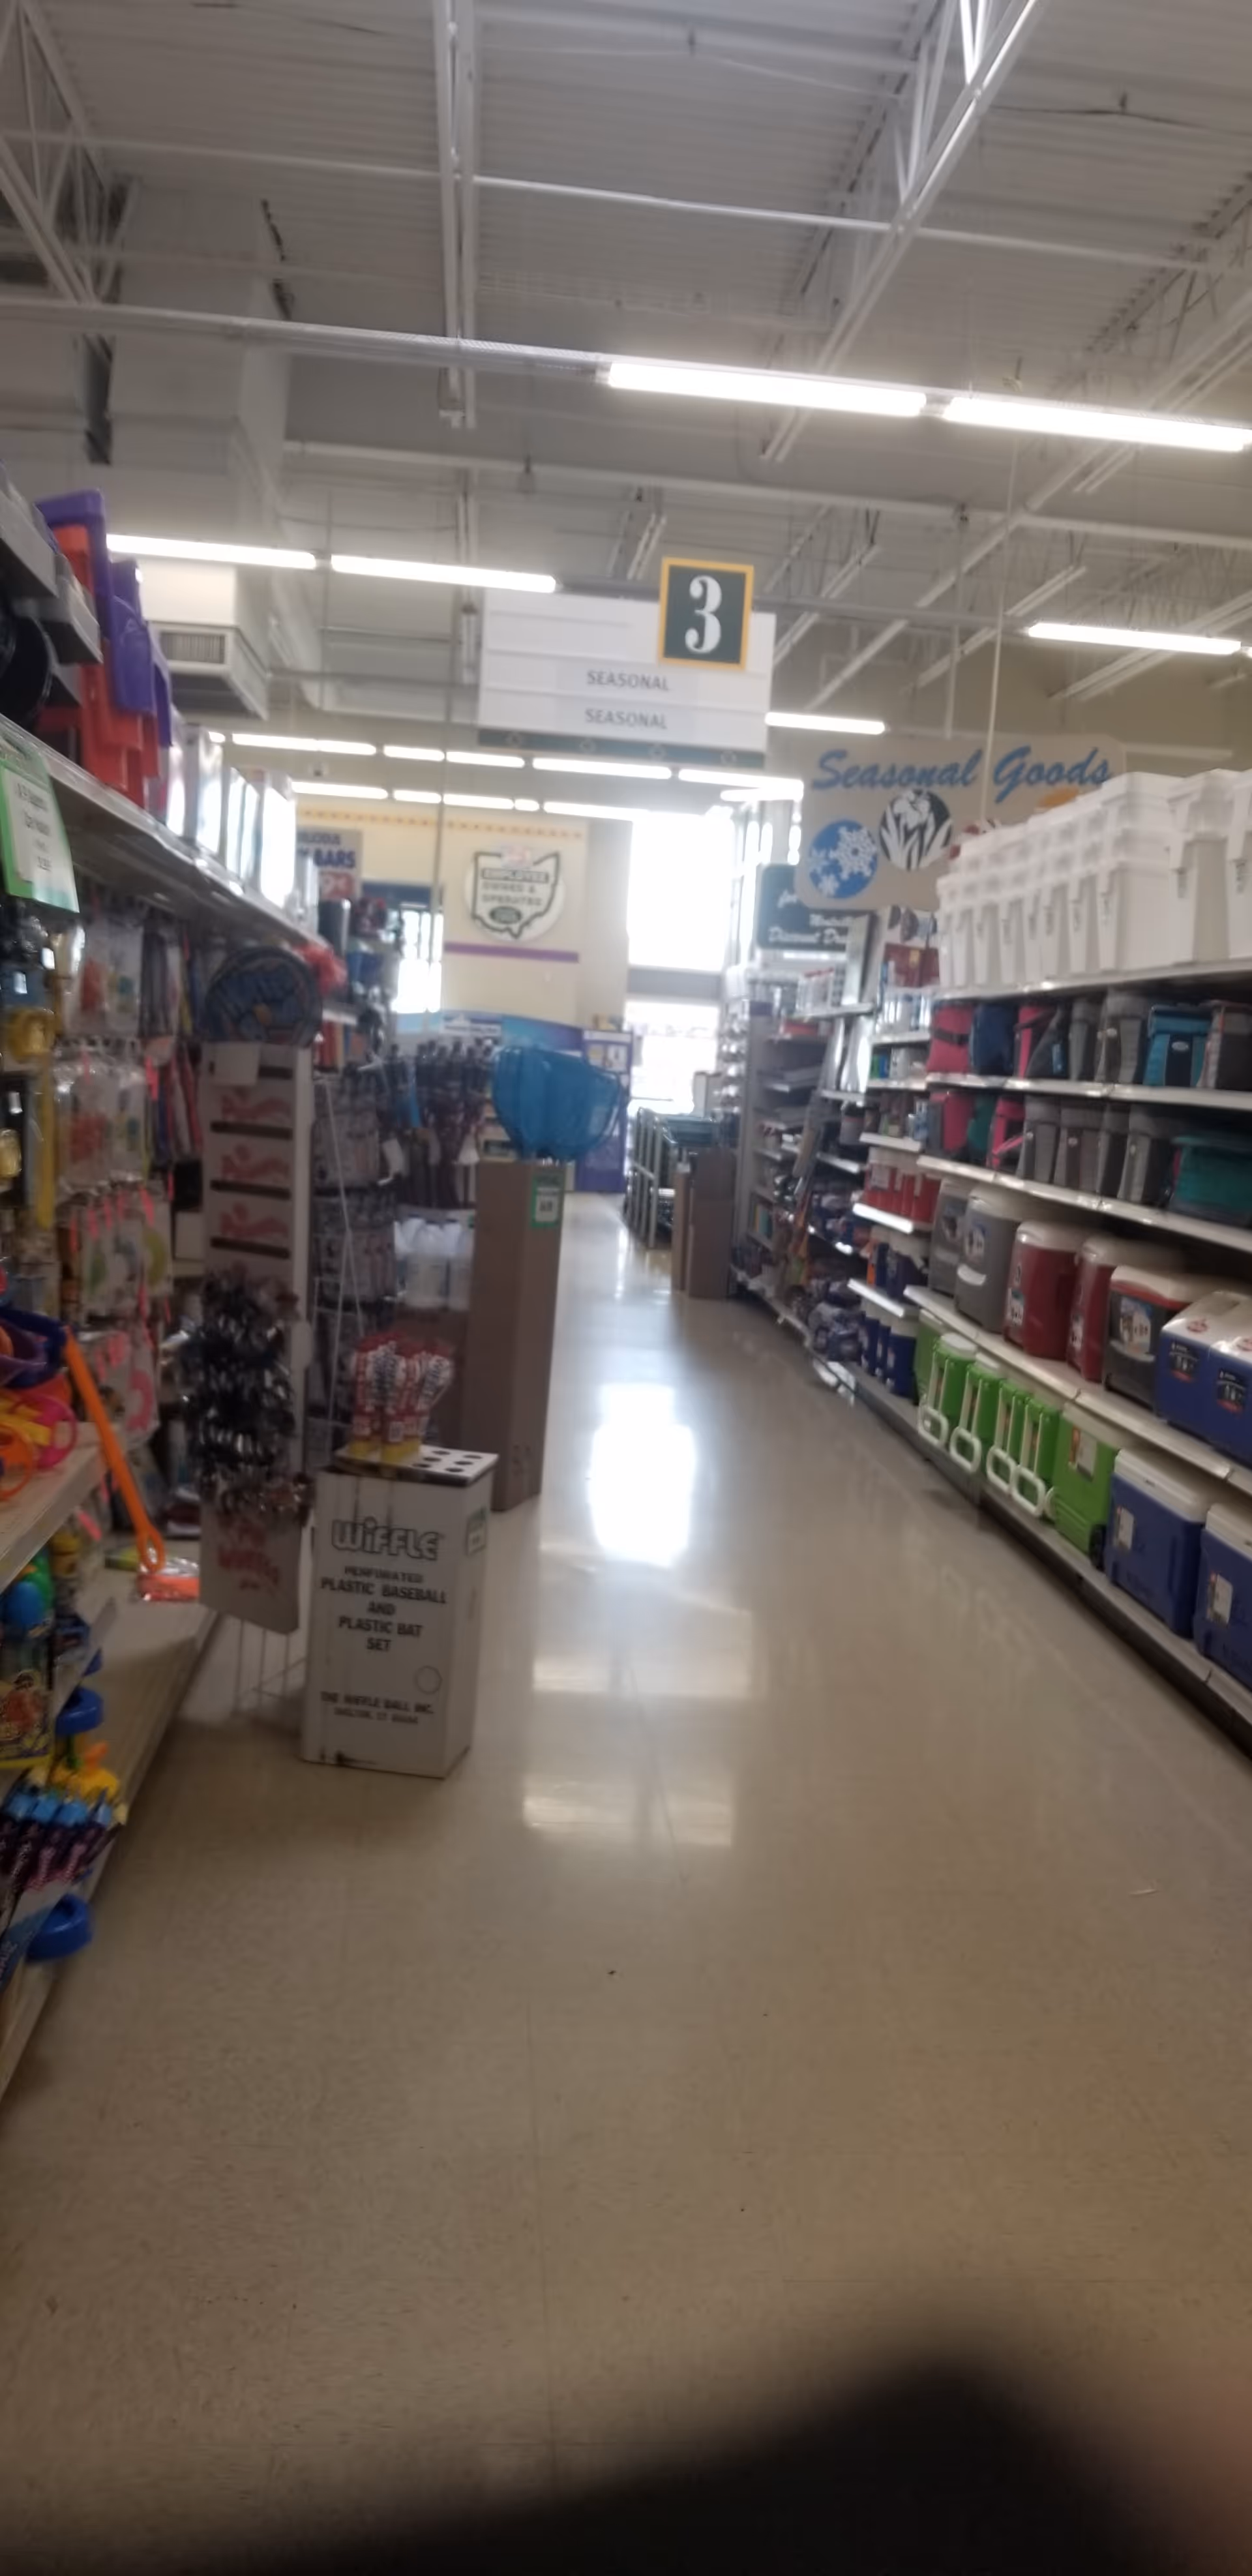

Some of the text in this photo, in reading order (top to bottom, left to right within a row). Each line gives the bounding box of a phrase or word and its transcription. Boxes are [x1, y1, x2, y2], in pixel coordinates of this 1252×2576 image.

[684, 575, 722, 654] 3
[586, 669, 671, 692] SEASONAL
[584, 708, 668, 730] SEASONAL
[812, 745, 1112, 803] Seasonal Goods
[345, 1566, 423, 1583] PERFORATED
[320, 1577, 447, 1604] PLASTIC BASEBALL
[367, 1601, 396, 1615] AND
[338, 1616, 423, 1636] PLASTIC BAT
[366, 1637, 391, 1651] SET
